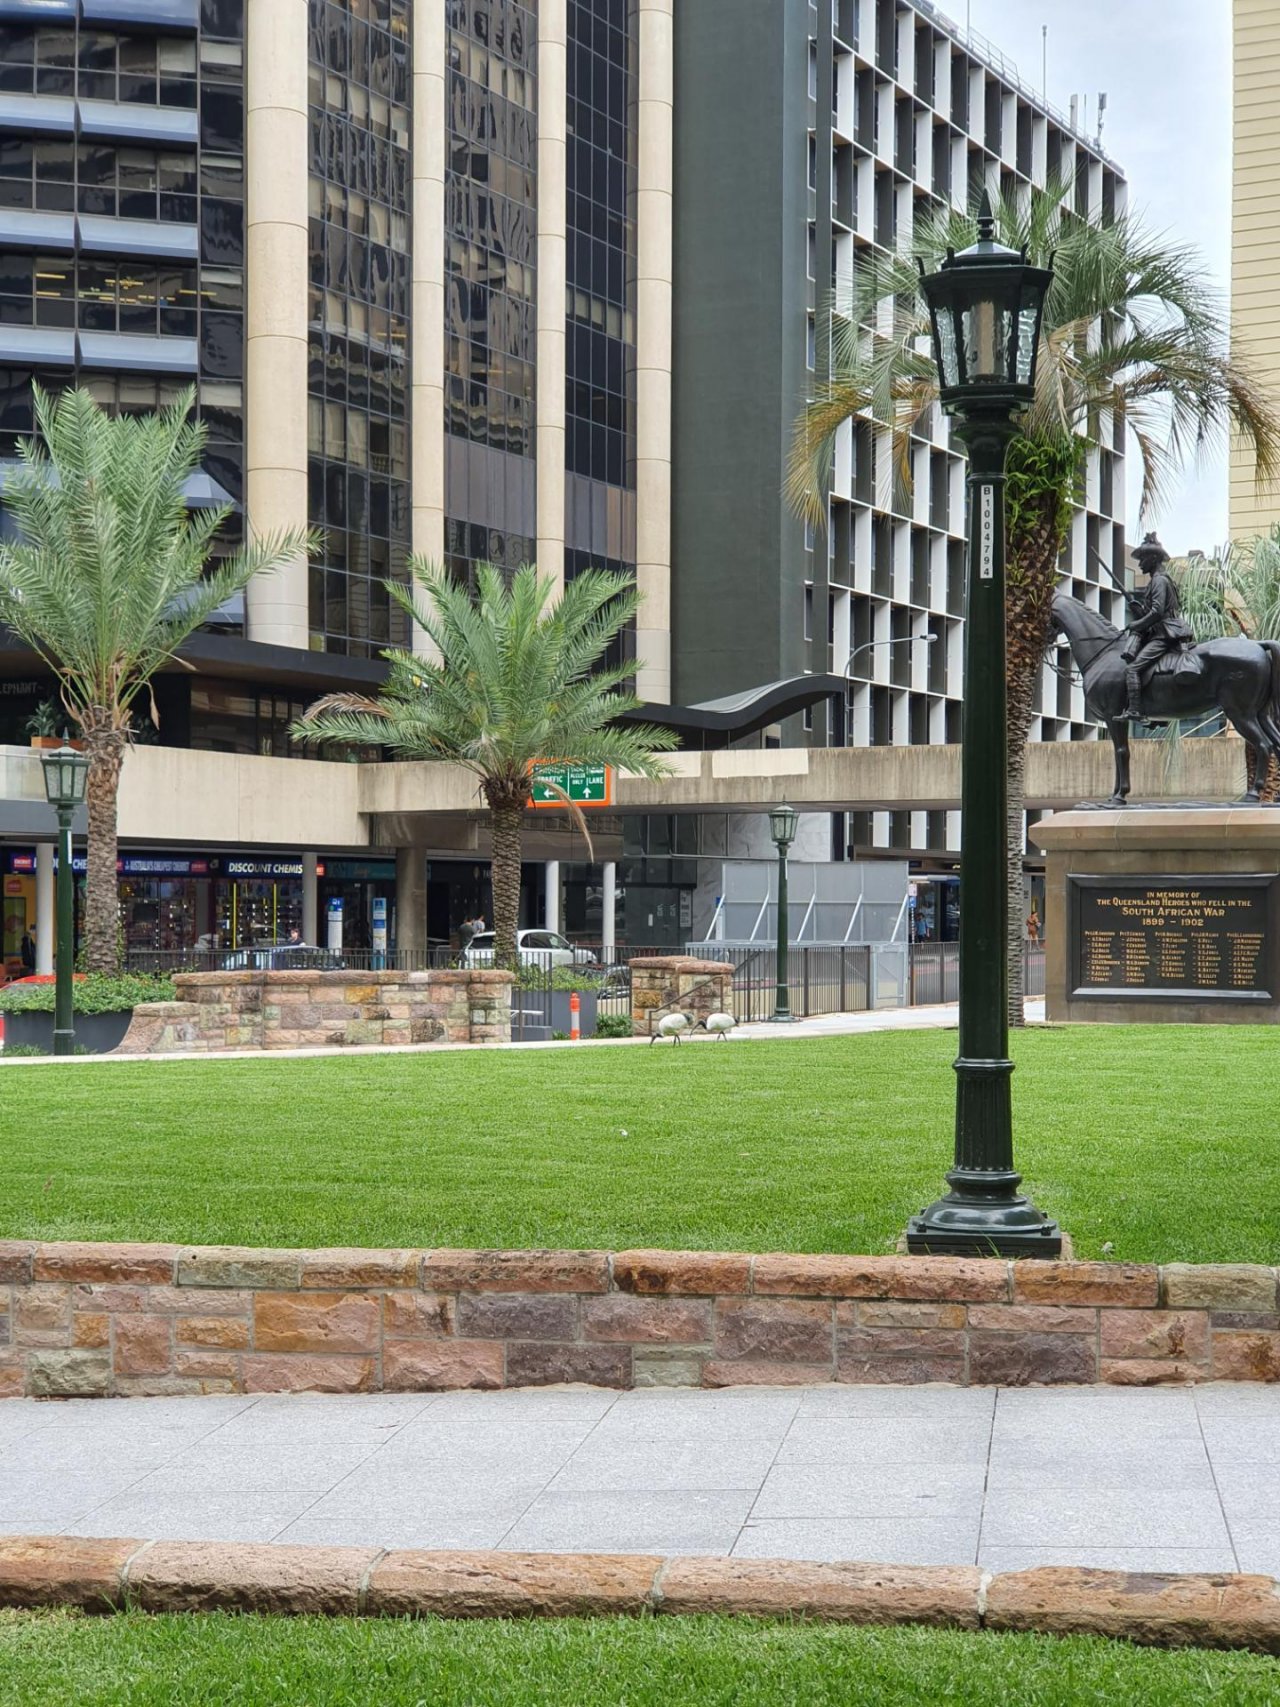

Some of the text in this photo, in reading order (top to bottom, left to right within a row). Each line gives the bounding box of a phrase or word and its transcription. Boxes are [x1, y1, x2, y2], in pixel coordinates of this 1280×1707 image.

[983, 486, 992, 577] B1004794
[228, 862, 272, 873] DISCOUNT
[273, 864, 304, 874] CHEMIS
[1096, 898, 1111, 906] THE
[1112, 897, 1160, 907] QUEENSLAND
[1162, 897, 1190, 907] HEROES
[1122, 907, 1225, 917] SOUTH AFRICAN WAR
[1142, 918, 1165, 926] 1899
[1181, 918, 1204, 926] 1902
